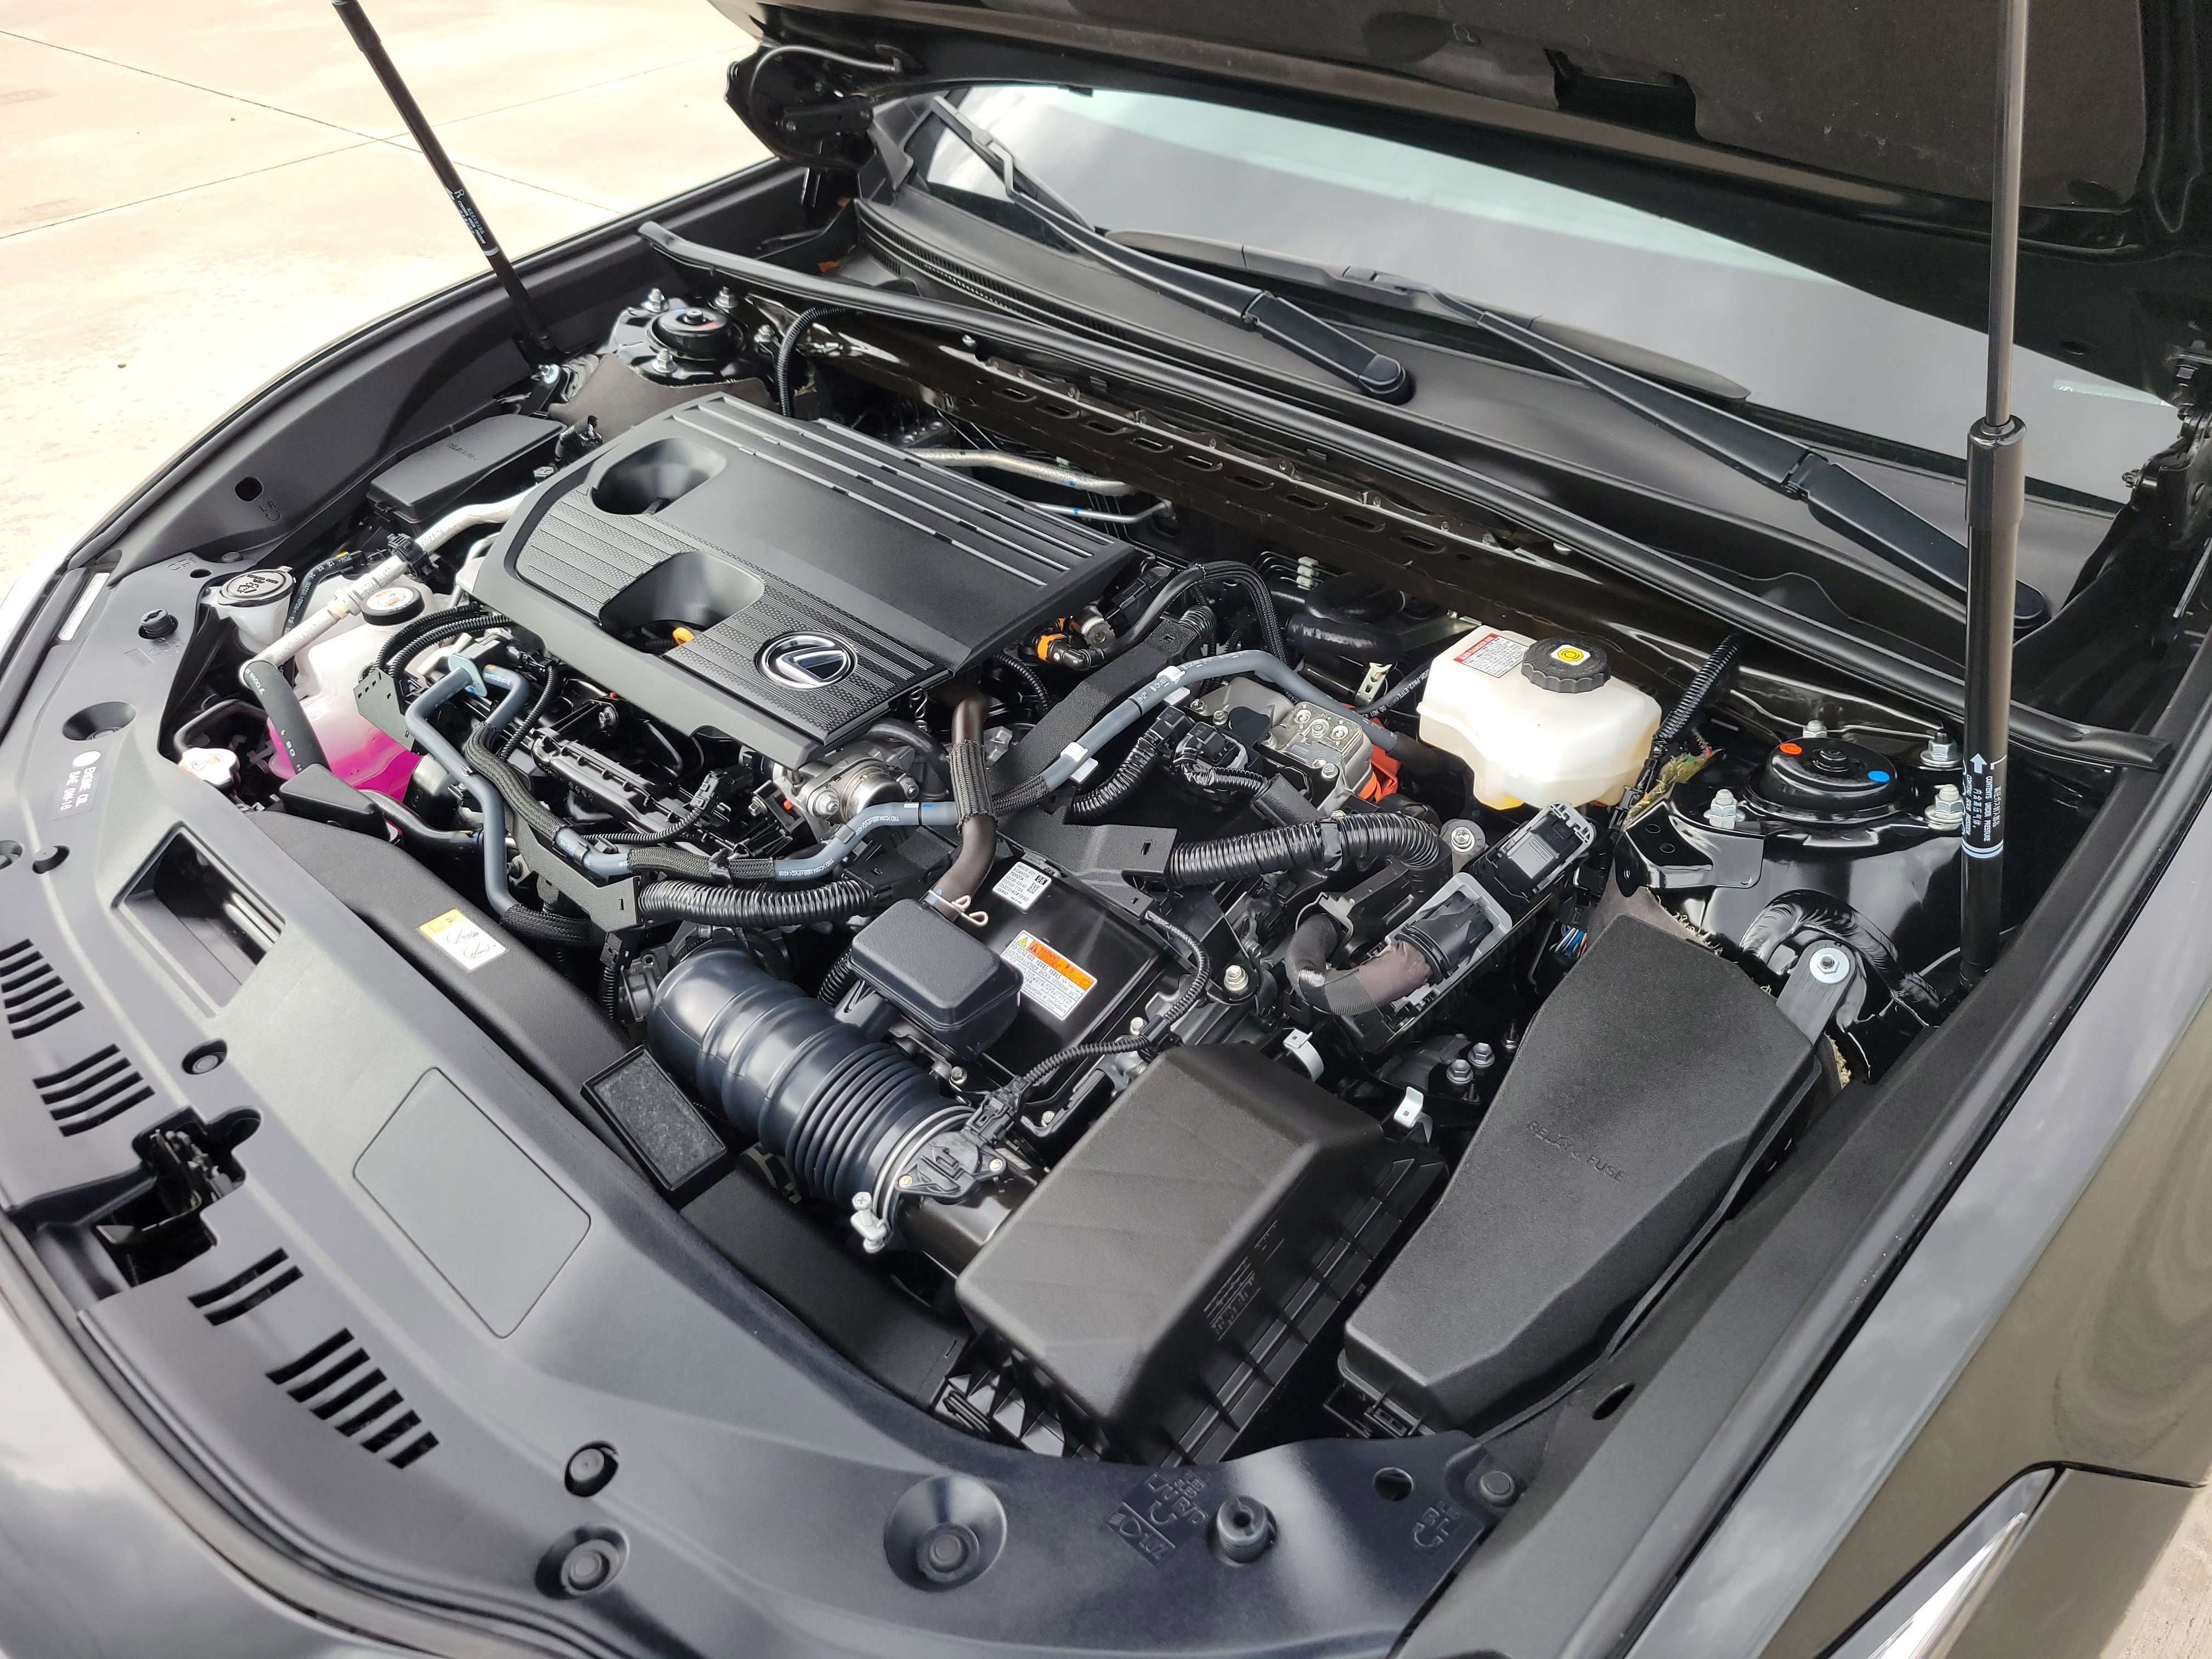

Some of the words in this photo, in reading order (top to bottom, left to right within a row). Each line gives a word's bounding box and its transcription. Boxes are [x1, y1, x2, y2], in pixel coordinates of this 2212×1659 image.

[454, 188, 465, 199] R
[301, 580, 312, 596] WATER
[66, 771, 81, 786] SAE
[78, 766, 96, 792] ENGINE
[1984, 776, 1993, 799] CONTENTS
[59, 788, 76, 810] 0W-16
[75, 794, 89, 807] OIL
[1983, 820, 1991, 842] PRESSURE
[1009, 871, 1024, 881] TOYOTA
[1036, 875, 1046, 884] 06
[997, 887, 1008, 896] DENSO
[1585, 1153, 1627, 1183] FUSE
